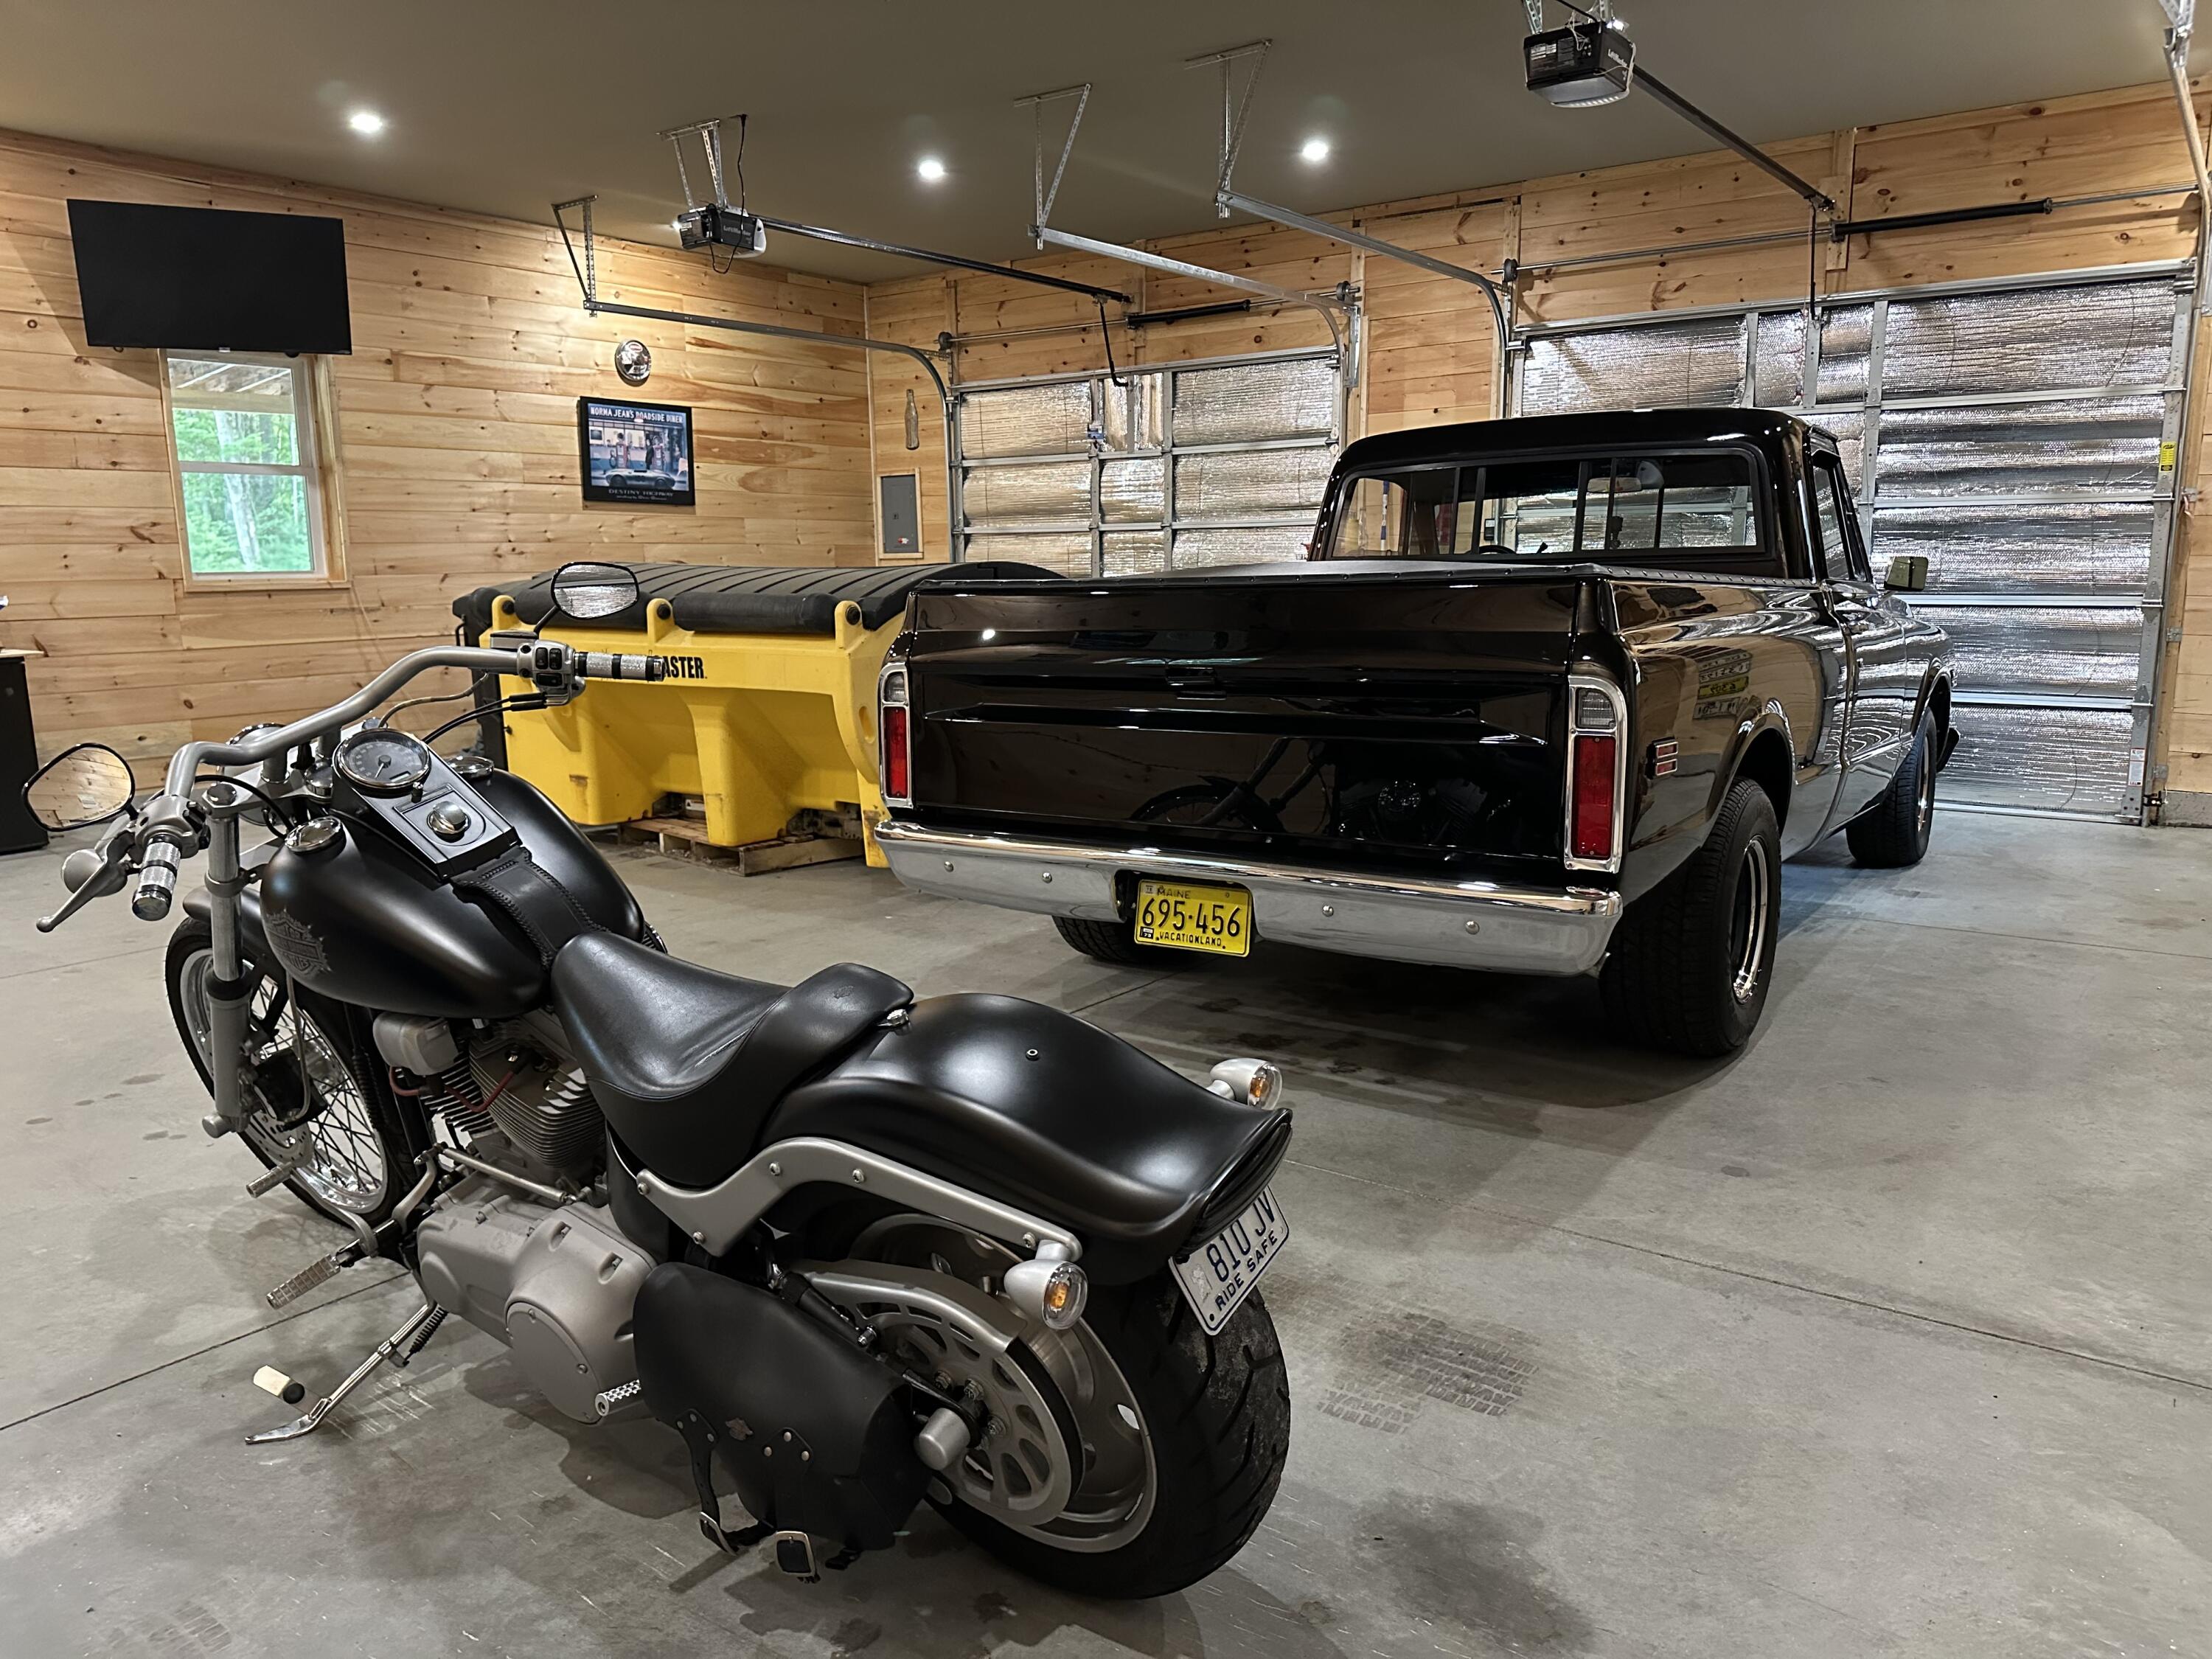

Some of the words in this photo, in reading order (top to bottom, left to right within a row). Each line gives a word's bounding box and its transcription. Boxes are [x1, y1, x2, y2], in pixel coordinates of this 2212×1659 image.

[591, 407, 613, 417] NORMA
[613, 408, 635, 418] JEAN'S
[636, 411, 665, 422] ROADSIDE
[666, 414, 683, 424] DINER
[662, 655, 704, 679] ASTER
[1157, 887, 1192, 899] MAINE
[1159, 931, 1222, 947] VACATIONLAND
[1253, 1191, 1275, 1237] JV
[1214, 1272, 1245, 1312] RIDE
[1246, 1229, 1278, 1273] SAFE
